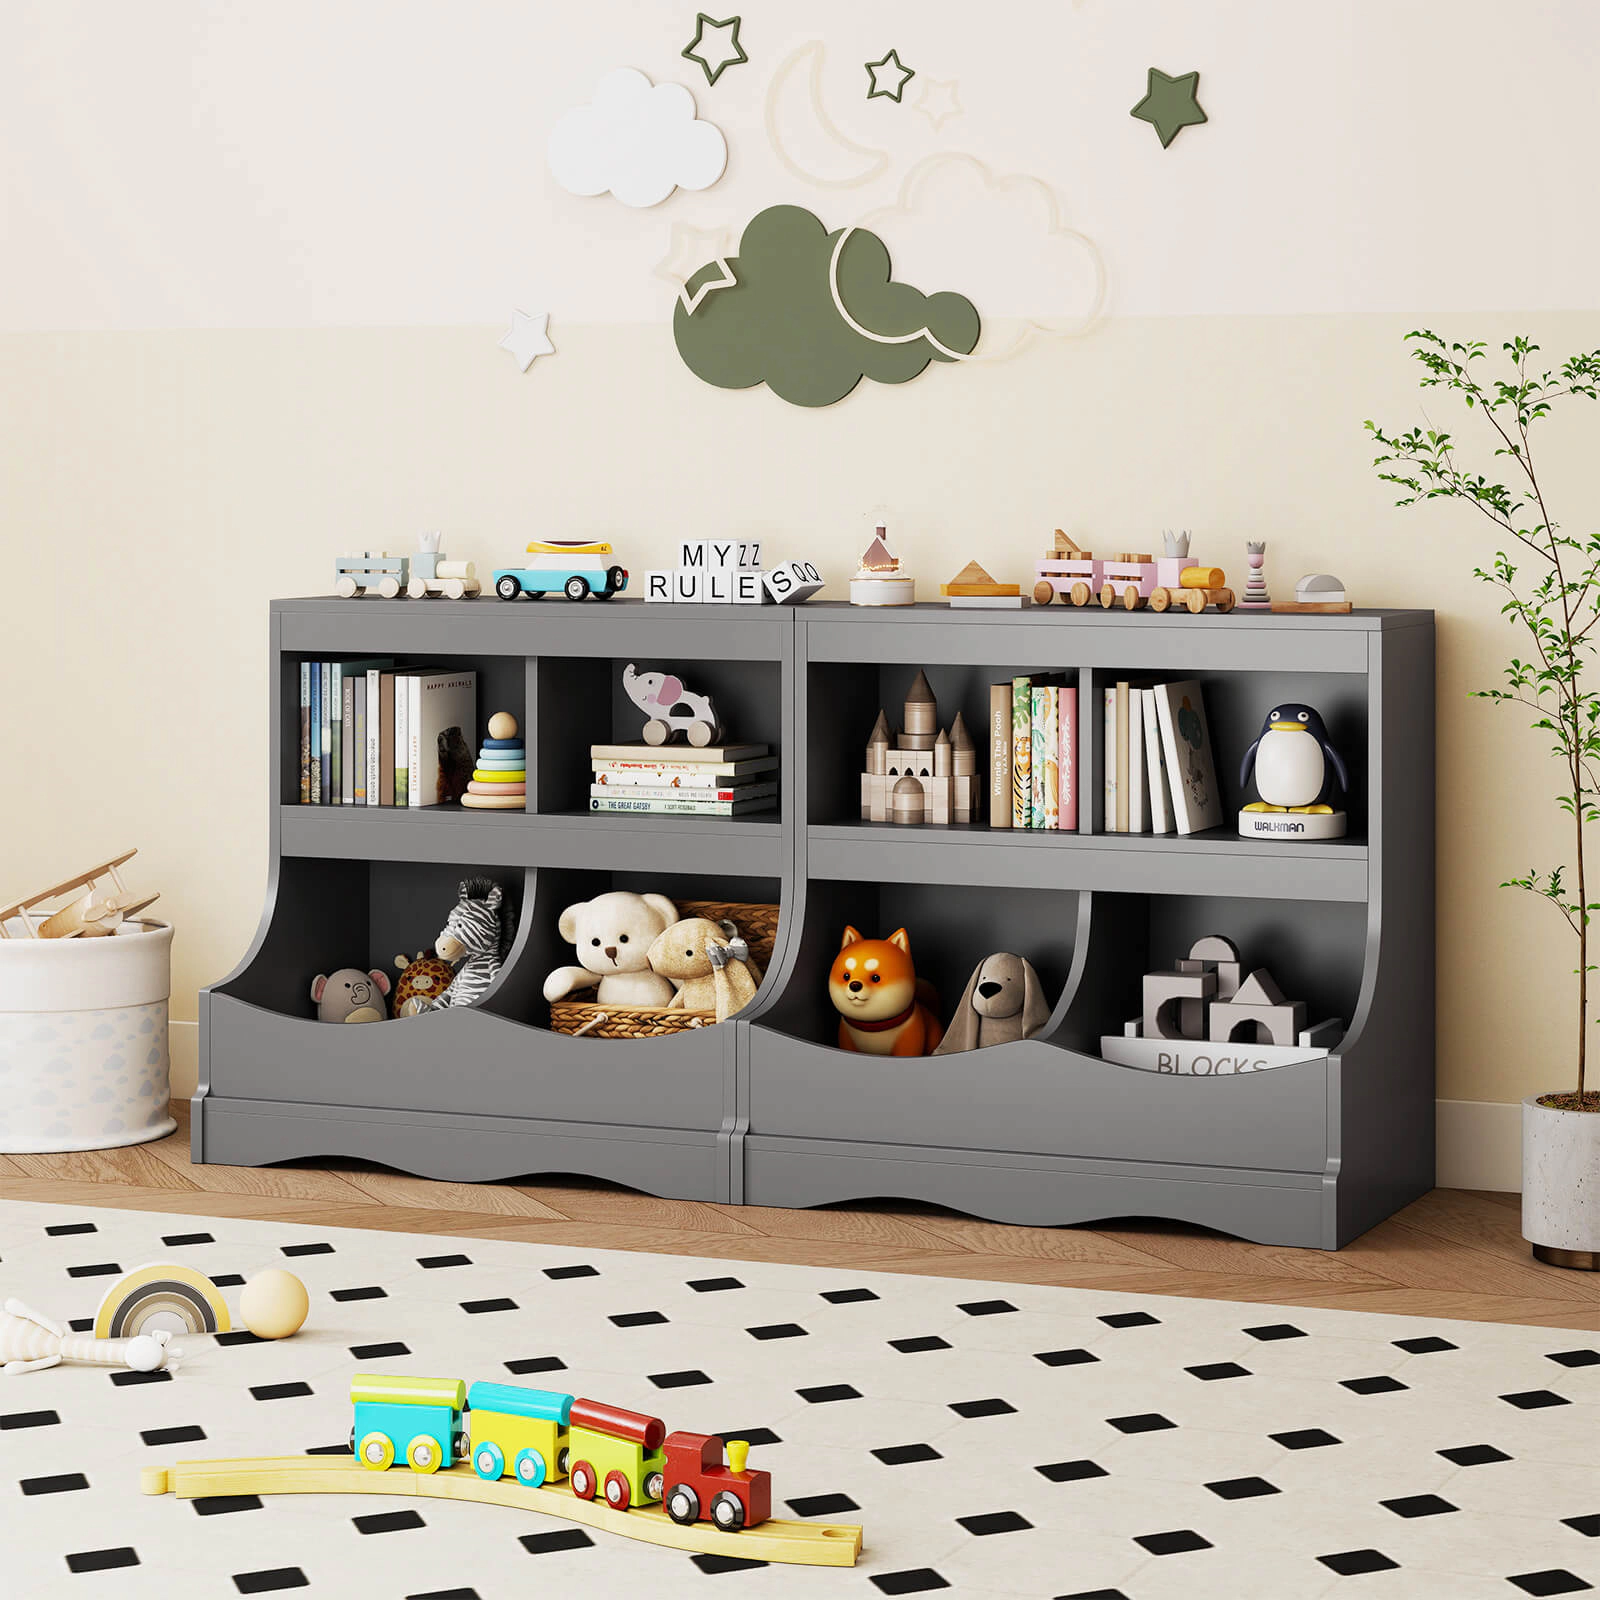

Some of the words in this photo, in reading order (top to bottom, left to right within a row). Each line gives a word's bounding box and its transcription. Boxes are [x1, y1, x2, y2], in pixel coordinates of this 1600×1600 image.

[683, 544, 731, 567] MY
[650, 570, 792, 599] RULES
[994, 711, 1002, 737] Pooh
[994, 739, 1002, 759] The
[994, 760, 1002, 796] Winnie
[608, 801, 617, 809] THE
[617, 801, 632, 810] GREAT
[1254, 821, 1305, 833] WALKMAN
